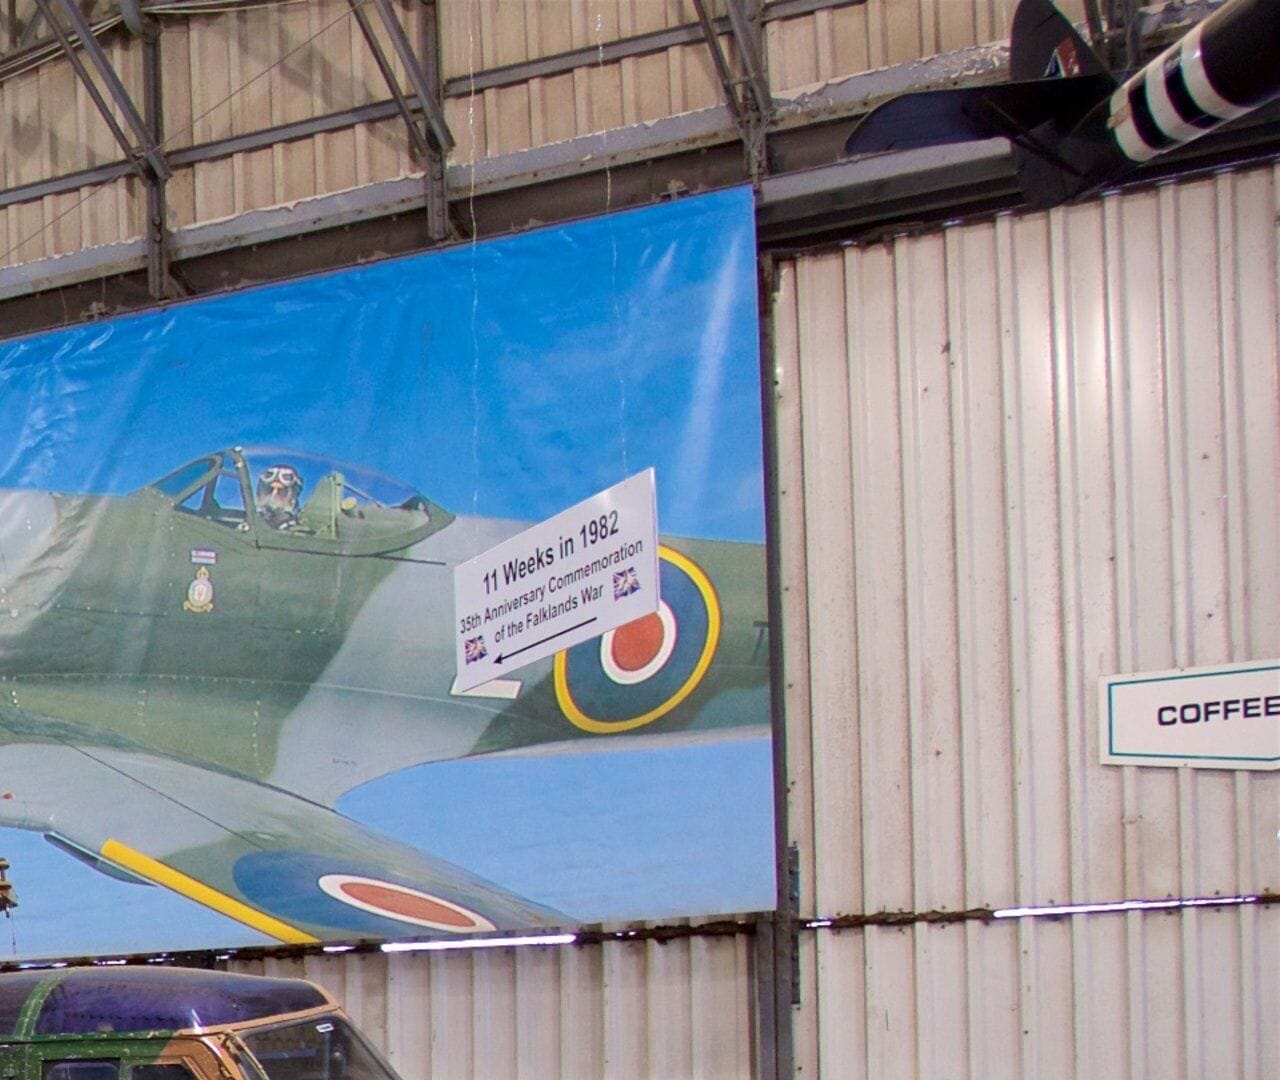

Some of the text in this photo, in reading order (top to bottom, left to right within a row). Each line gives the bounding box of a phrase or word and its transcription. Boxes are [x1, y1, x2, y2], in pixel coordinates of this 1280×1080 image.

[460, 539, 643, 635] 35th Anniversary Commemoration
[482, 510, 619, 596] 11 Weeks in 1982
[494, 583, 604, 644] of the Falklands War
[1157, 695, 1280, 726] COFFEE
